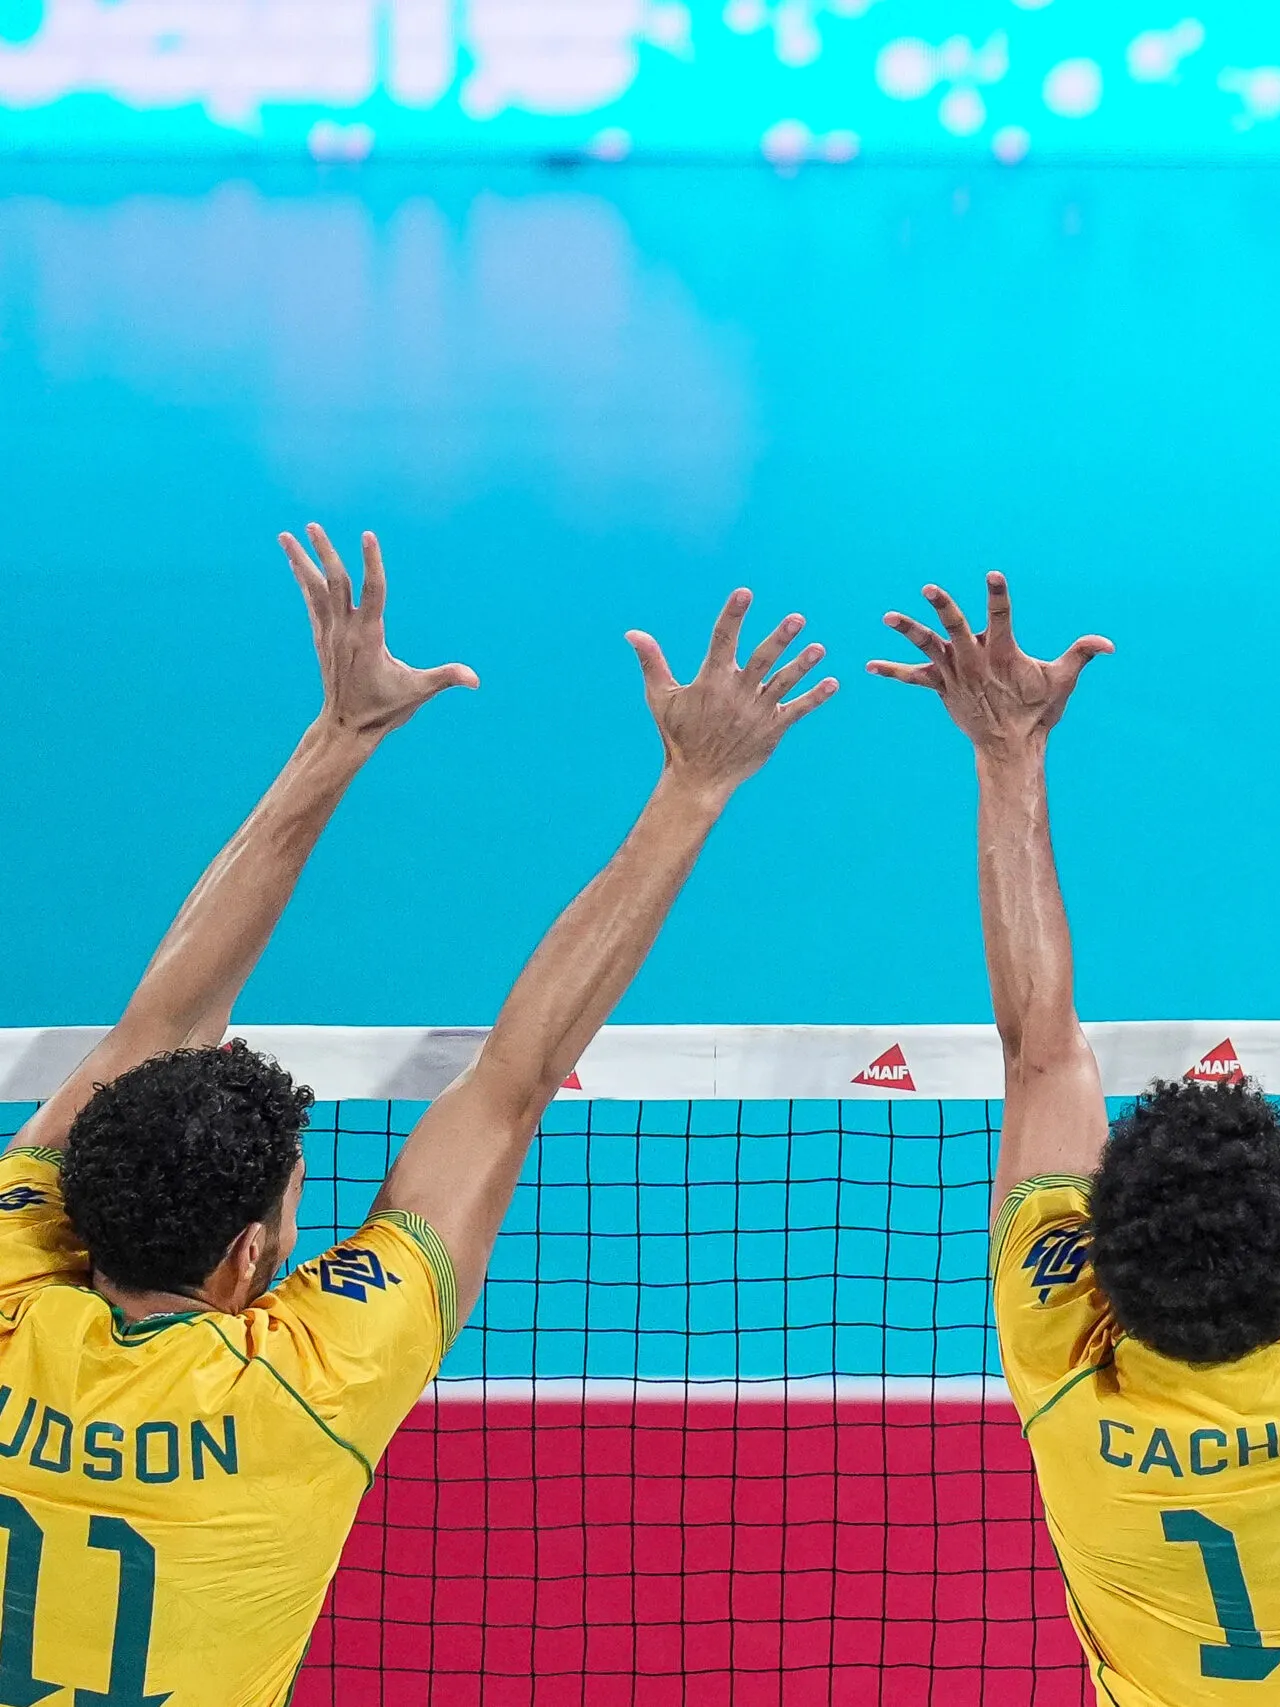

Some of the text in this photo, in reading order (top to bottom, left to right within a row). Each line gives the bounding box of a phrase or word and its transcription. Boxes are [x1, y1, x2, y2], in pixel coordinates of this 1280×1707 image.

[863, 1065, 909, 1080] MAIF
[1194, 1059, 1240, 1075] MAIF
[0, 1493, 175, 1707] 11
